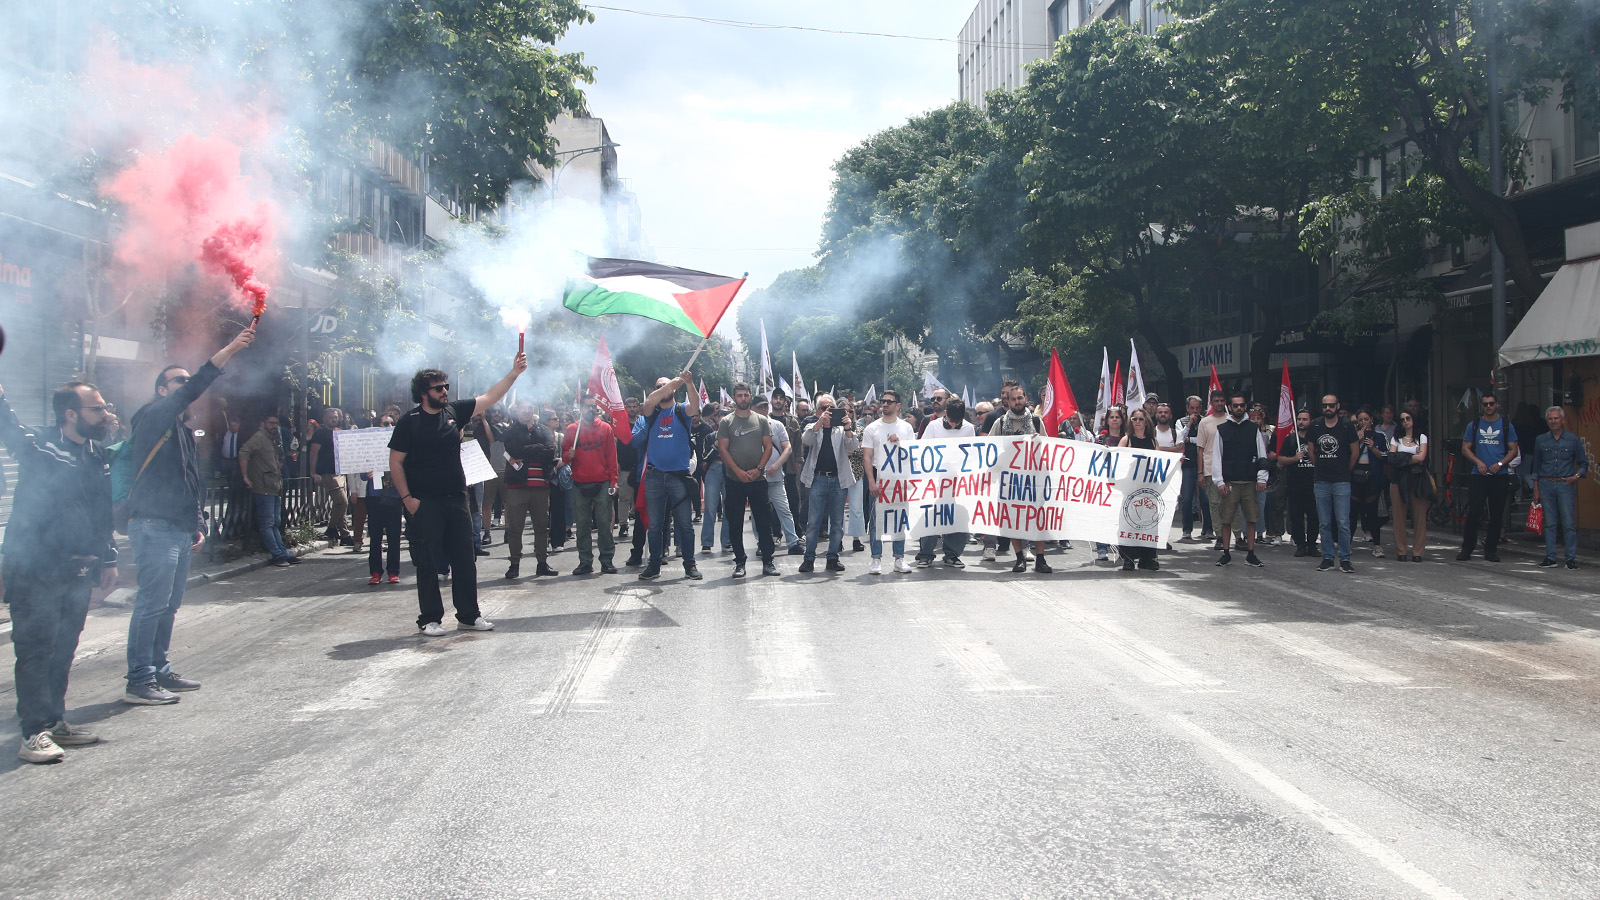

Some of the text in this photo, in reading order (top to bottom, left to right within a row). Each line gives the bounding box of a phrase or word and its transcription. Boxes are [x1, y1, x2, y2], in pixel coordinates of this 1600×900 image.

[310, 315, 338, 333] JD
[1198, 343, 1232, 367] ΑΚΜΗ
[881, 440, 1171, 484] ΧΡΕΟΣ ΣΤΟ ΣΙΚΑΓΟ ΚΑΙ ΤΗΝ
[879, 471, 1115, 507] ΚΑΙΣΑΡΙΑΝΗ ΕΙΝΑΙ Ο ΑΓΩΝΑΣ
[884, 500, 1064, 534] ΓΙΑ ΤΗΝ ΑΝΑΤΡΟΠΗ
